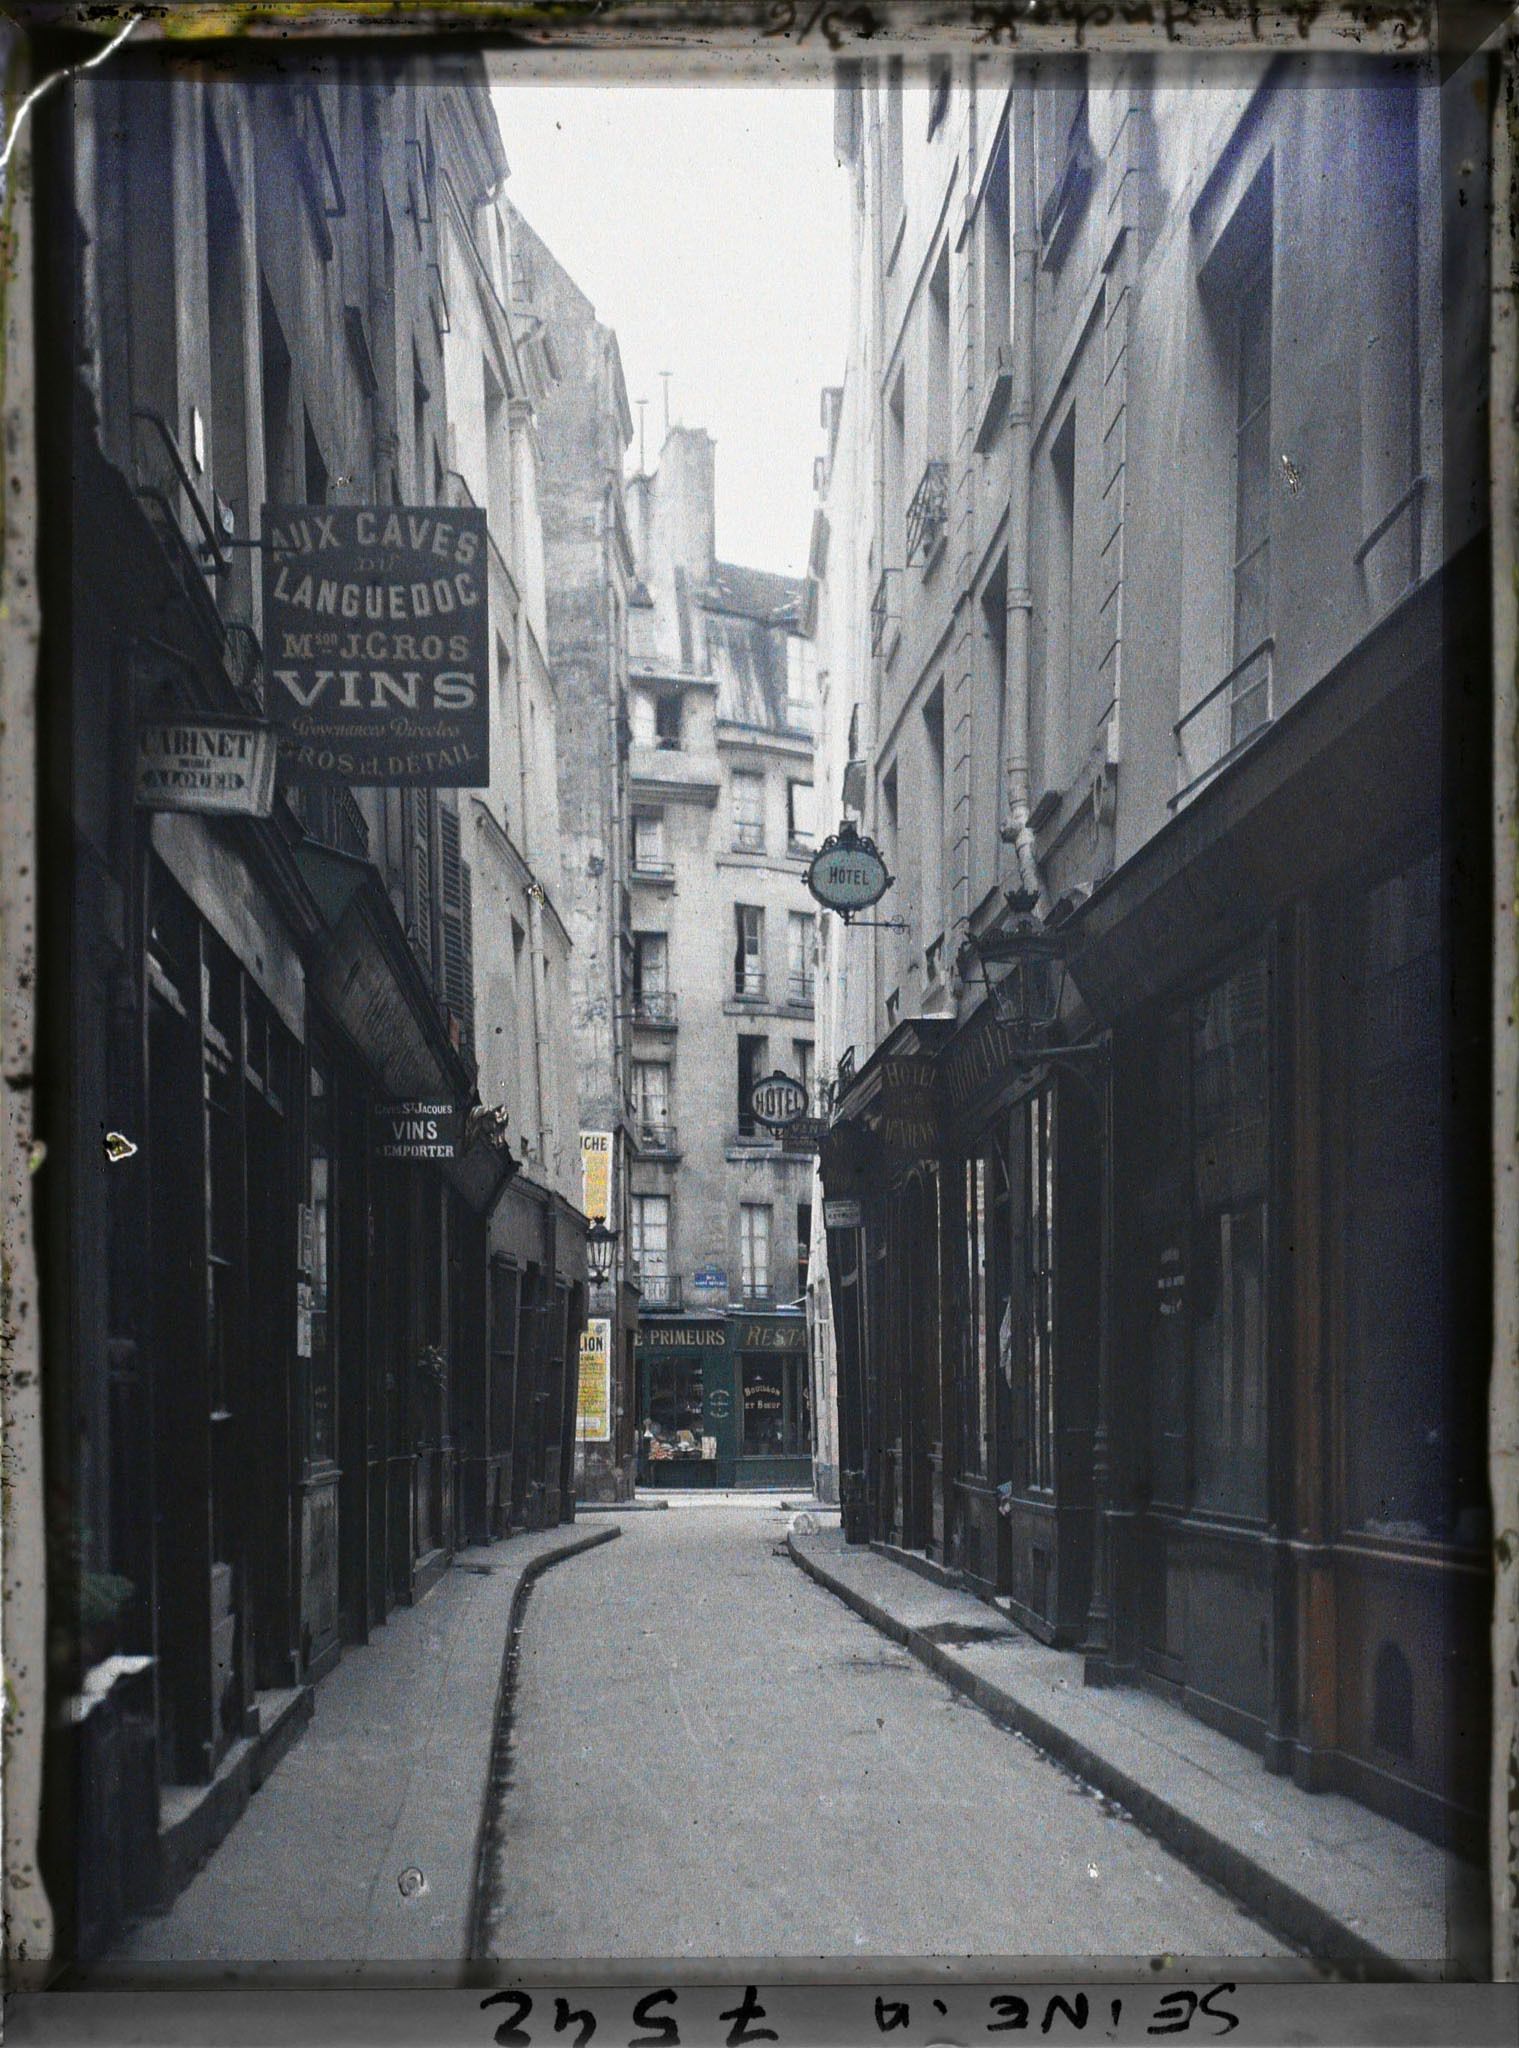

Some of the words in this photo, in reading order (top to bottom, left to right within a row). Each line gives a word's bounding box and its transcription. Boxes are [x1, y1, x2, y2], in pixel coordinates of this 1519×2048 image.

[272, 514, 341, 562] AUX
[356, 512, 478, 564] CAVES
[273, 566, 478, 619] LANGUEDOC
[273, 670, 477, 709] VINS
[141, 728, 254, 758] CABINET
[388, 743, 480, 775] DETAIL
[414, 1102, 454, 1116] JACQUES
[392, 1119, 439, 1141] VINS
[384, 1144, 455, 1158] EMPORTER
[650, 1329, 726, 1347] PRIMEURS
